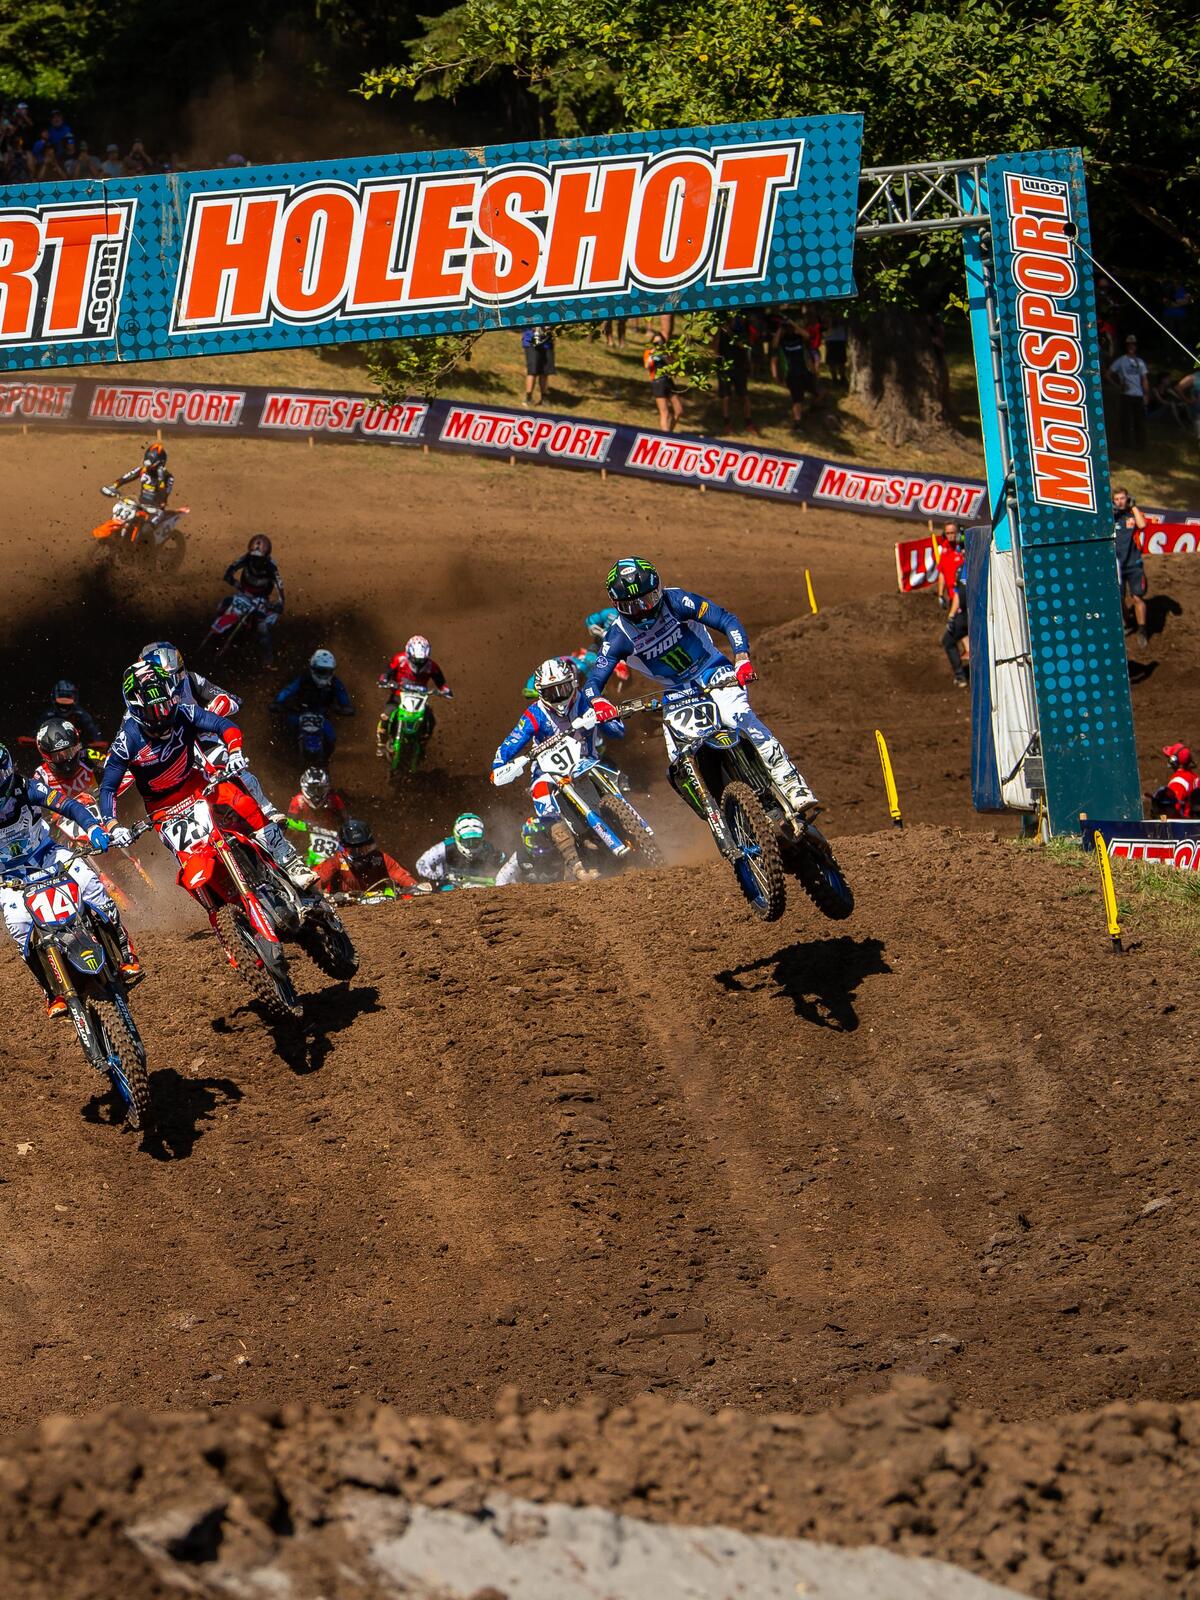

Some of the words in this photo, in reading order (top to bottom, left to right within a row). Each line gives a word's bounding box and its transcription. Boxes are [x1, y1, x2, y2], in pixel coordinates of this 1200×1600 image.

[1022, 176, 1067, 194] .com
[182, 150, 798, 327] HOLESHOT
[88, 243, 122, 333] .com
[642, 627, 684, 661] THOR
[673, 702, 715, 729] 29
[550, 745, 575, 771] 97
[312, 838, 337, 857] 83
[31, 883, 79, 923] 14
